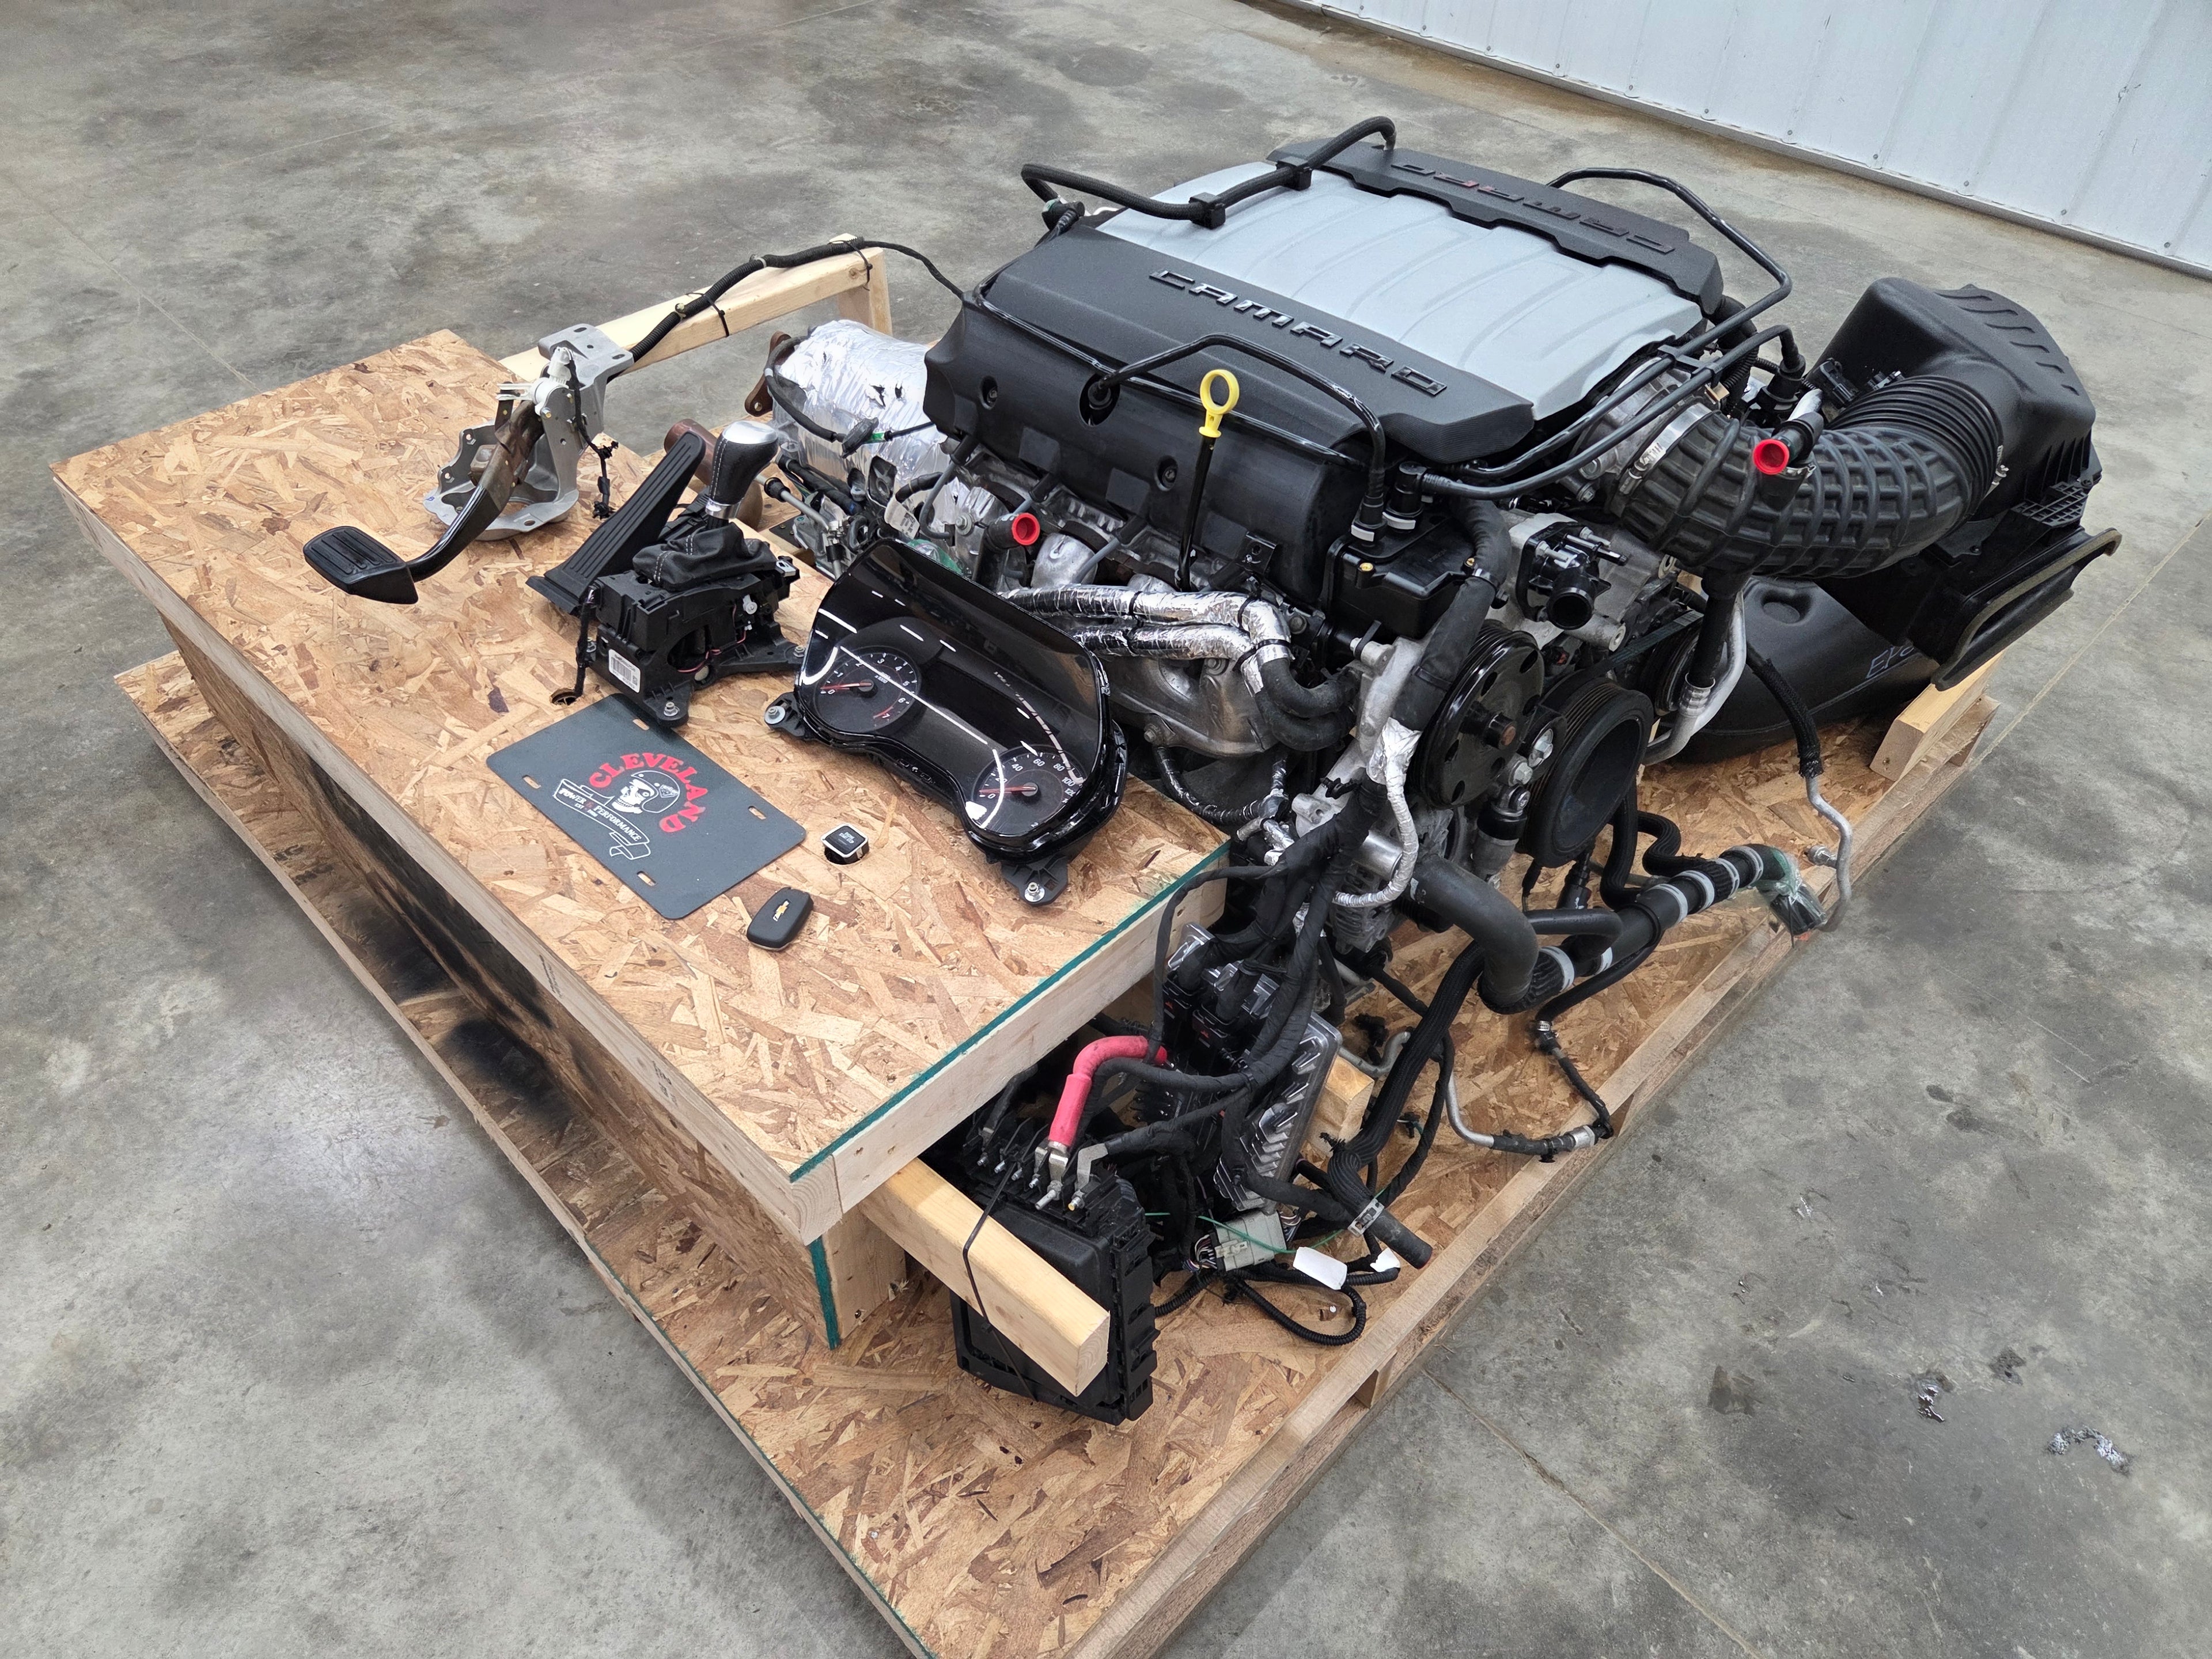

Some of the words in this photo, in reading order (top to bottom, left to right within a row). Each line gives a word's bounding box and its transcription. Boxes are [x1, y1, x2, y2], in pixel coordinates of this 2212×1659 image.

[1391, 163, 1675, 255] CAMARO
[1149, 269, 1447, 397] CAMARO
[1012, 763, 1023, 771] 40
[1033, 758, 1046, 767] 60
[1053, 763, 1065, 771] 80
[589, 752, 708, 832] CLEVELAND
[1062, 777, 1076, 787] 100
[558, 788, 586, 804] POWER
[593, 805, 642, 842] PERFORMANCE
